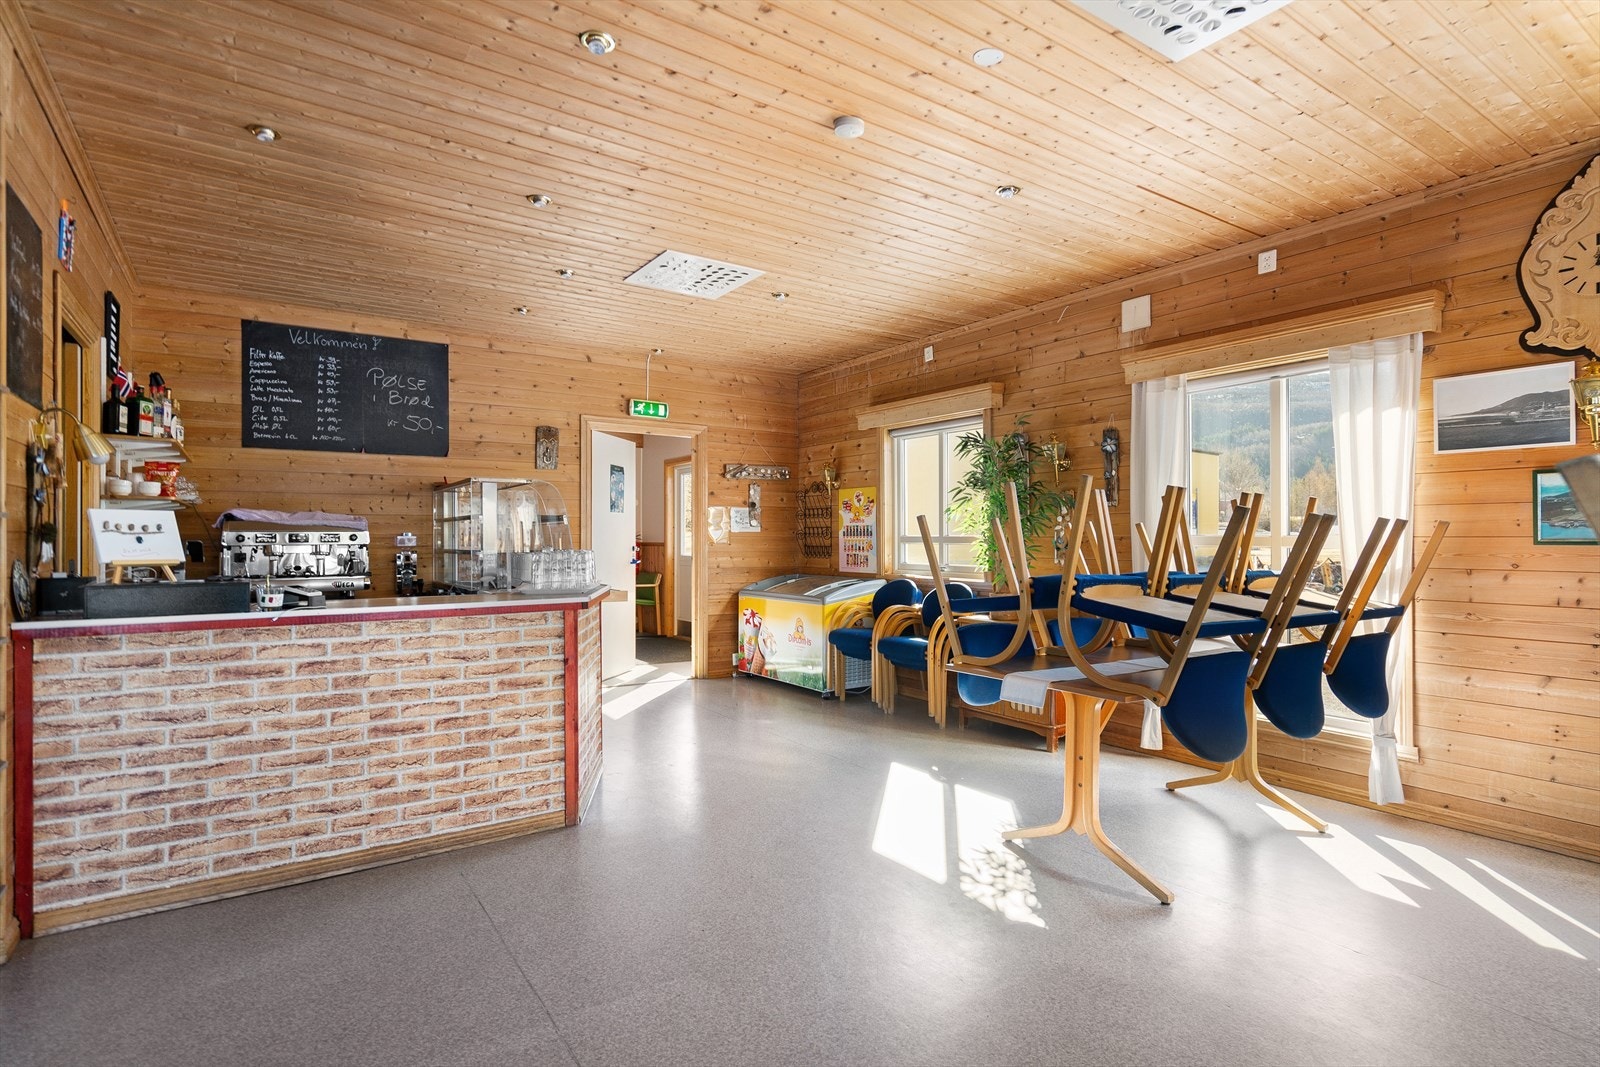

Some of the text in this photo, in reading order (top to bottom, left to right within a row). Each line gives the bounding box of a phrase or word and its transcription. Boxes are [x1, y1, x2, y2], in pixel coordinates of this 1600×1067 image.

[289, 328, 368, 350] Velkommen
[366, 367, 427, 390] PØLSE
[388, 390, 434, 409] Brød
[402, 414, 444, 435] 50,-
